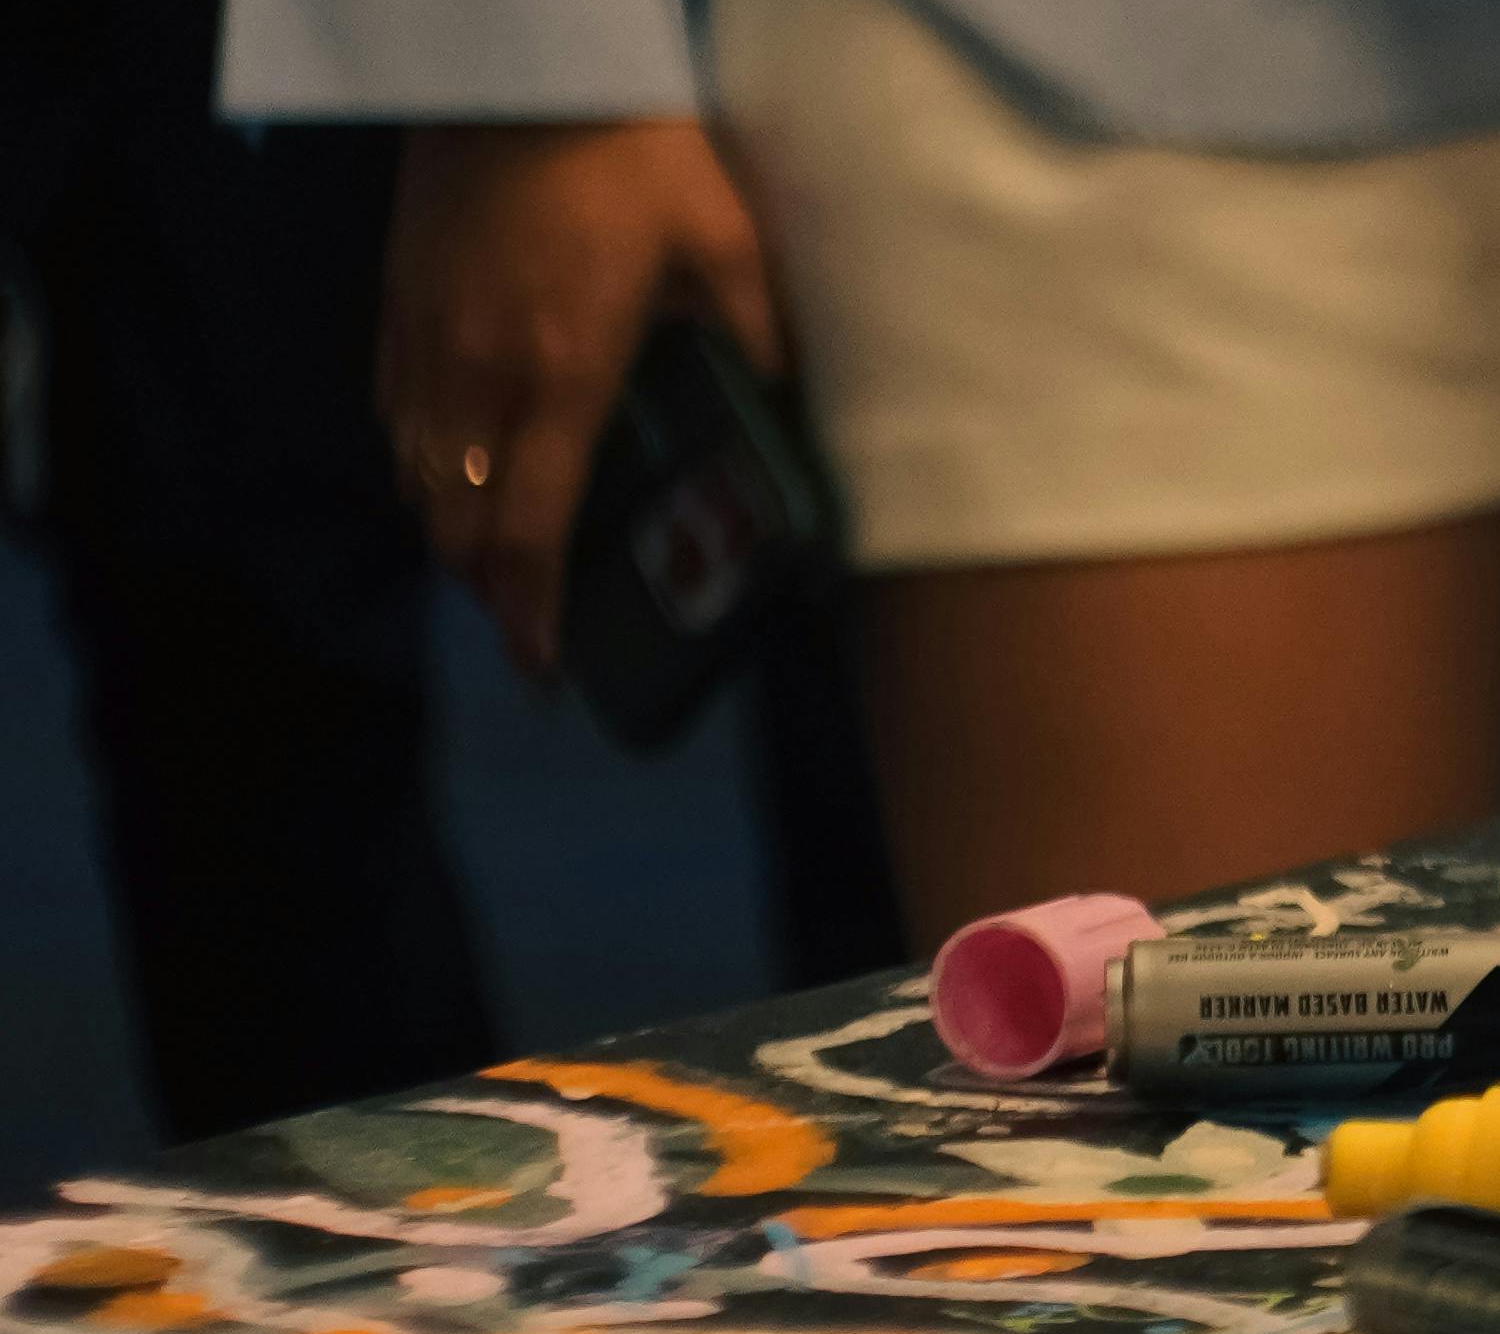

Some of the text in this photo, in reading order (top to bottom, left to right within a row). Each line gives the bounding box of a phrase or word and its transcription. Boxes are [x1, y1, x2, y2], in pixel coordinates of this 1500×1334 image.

[1199, 991, 1450, 1020] WATER BASED MARKER
[1283, 1034, 1394, 1063] WRITING
